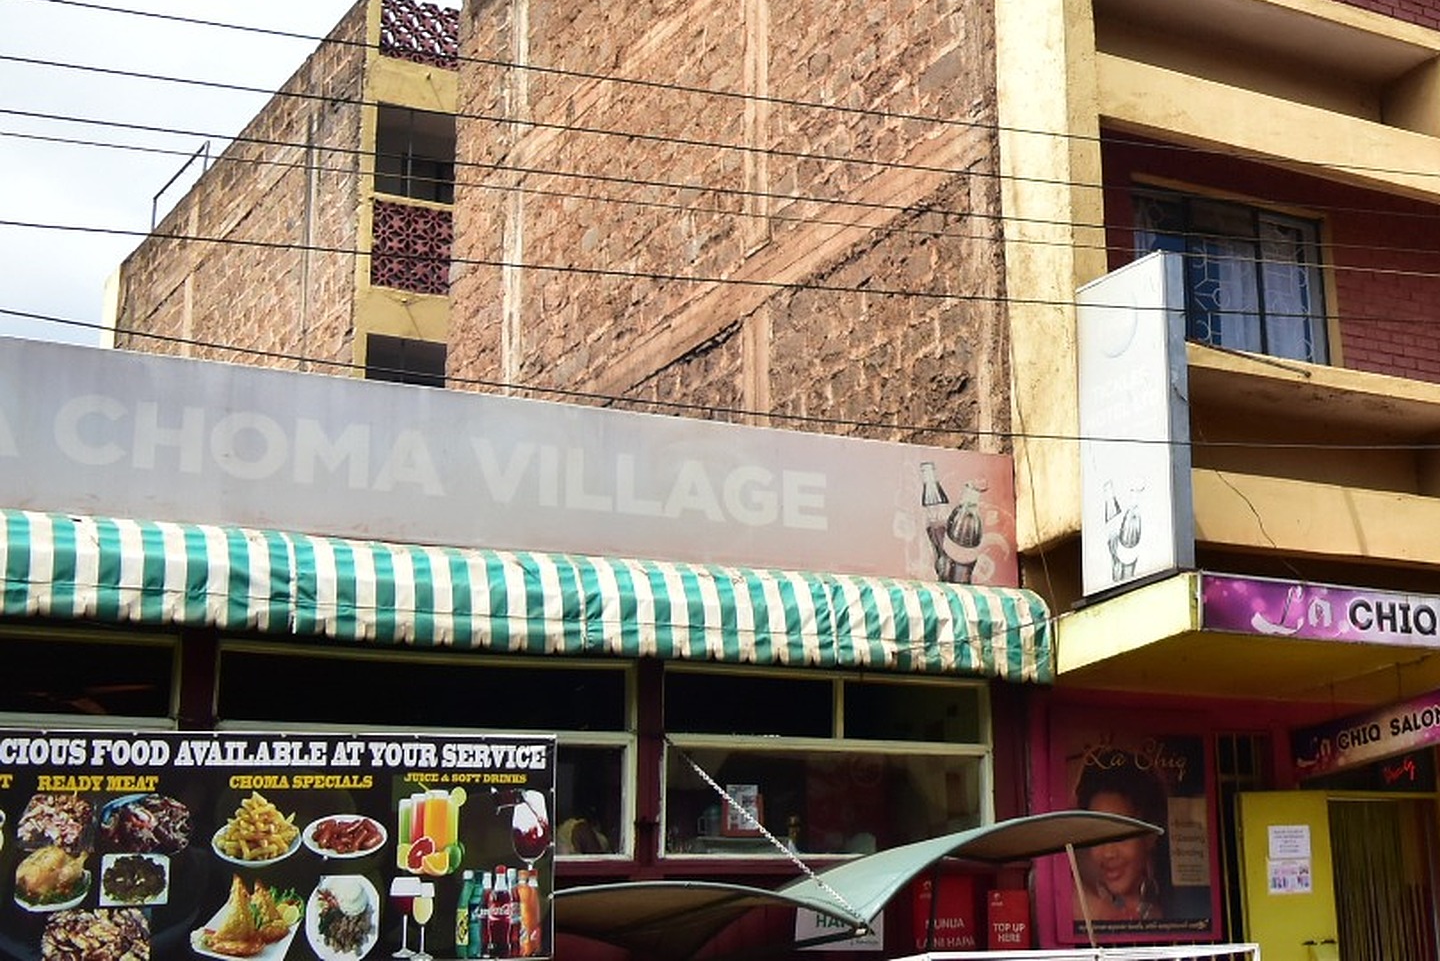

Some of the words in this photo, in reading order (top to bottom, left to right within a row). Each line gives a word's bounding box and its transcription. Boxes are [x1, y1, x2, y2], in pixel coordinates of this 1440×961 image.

[54, 394, 446, 497] CHOMA
[471, 438, 828, 531] VILLAGE
[0, 738, 87, 766] CIOUS
[91, 739, 170, 767] FOOD
[174, 741, 327, 767] AVAILABLE
[331, 741, 365, 767] AT
[368, 742, 438, 768] YOUR
[441, 744, 547, 770] SERVICE
[37, 775, 101, 792] READY
[106, 776, 159, 792] MEAT
[229, 775, 289, 790] CHOMA
[292, 775, 373, 789] SPECIALS
[404, 772, 439, 783] JUICE
[441, 773, 449, 783] &
[452, 772, 481, 784] SOFT
[483, 773, 528, 785] DRINKS
[993, 922, 1011, 933] TOP
[1012, 923, 1026, 933] UP
[998, 933, 1021, 943] HERE
